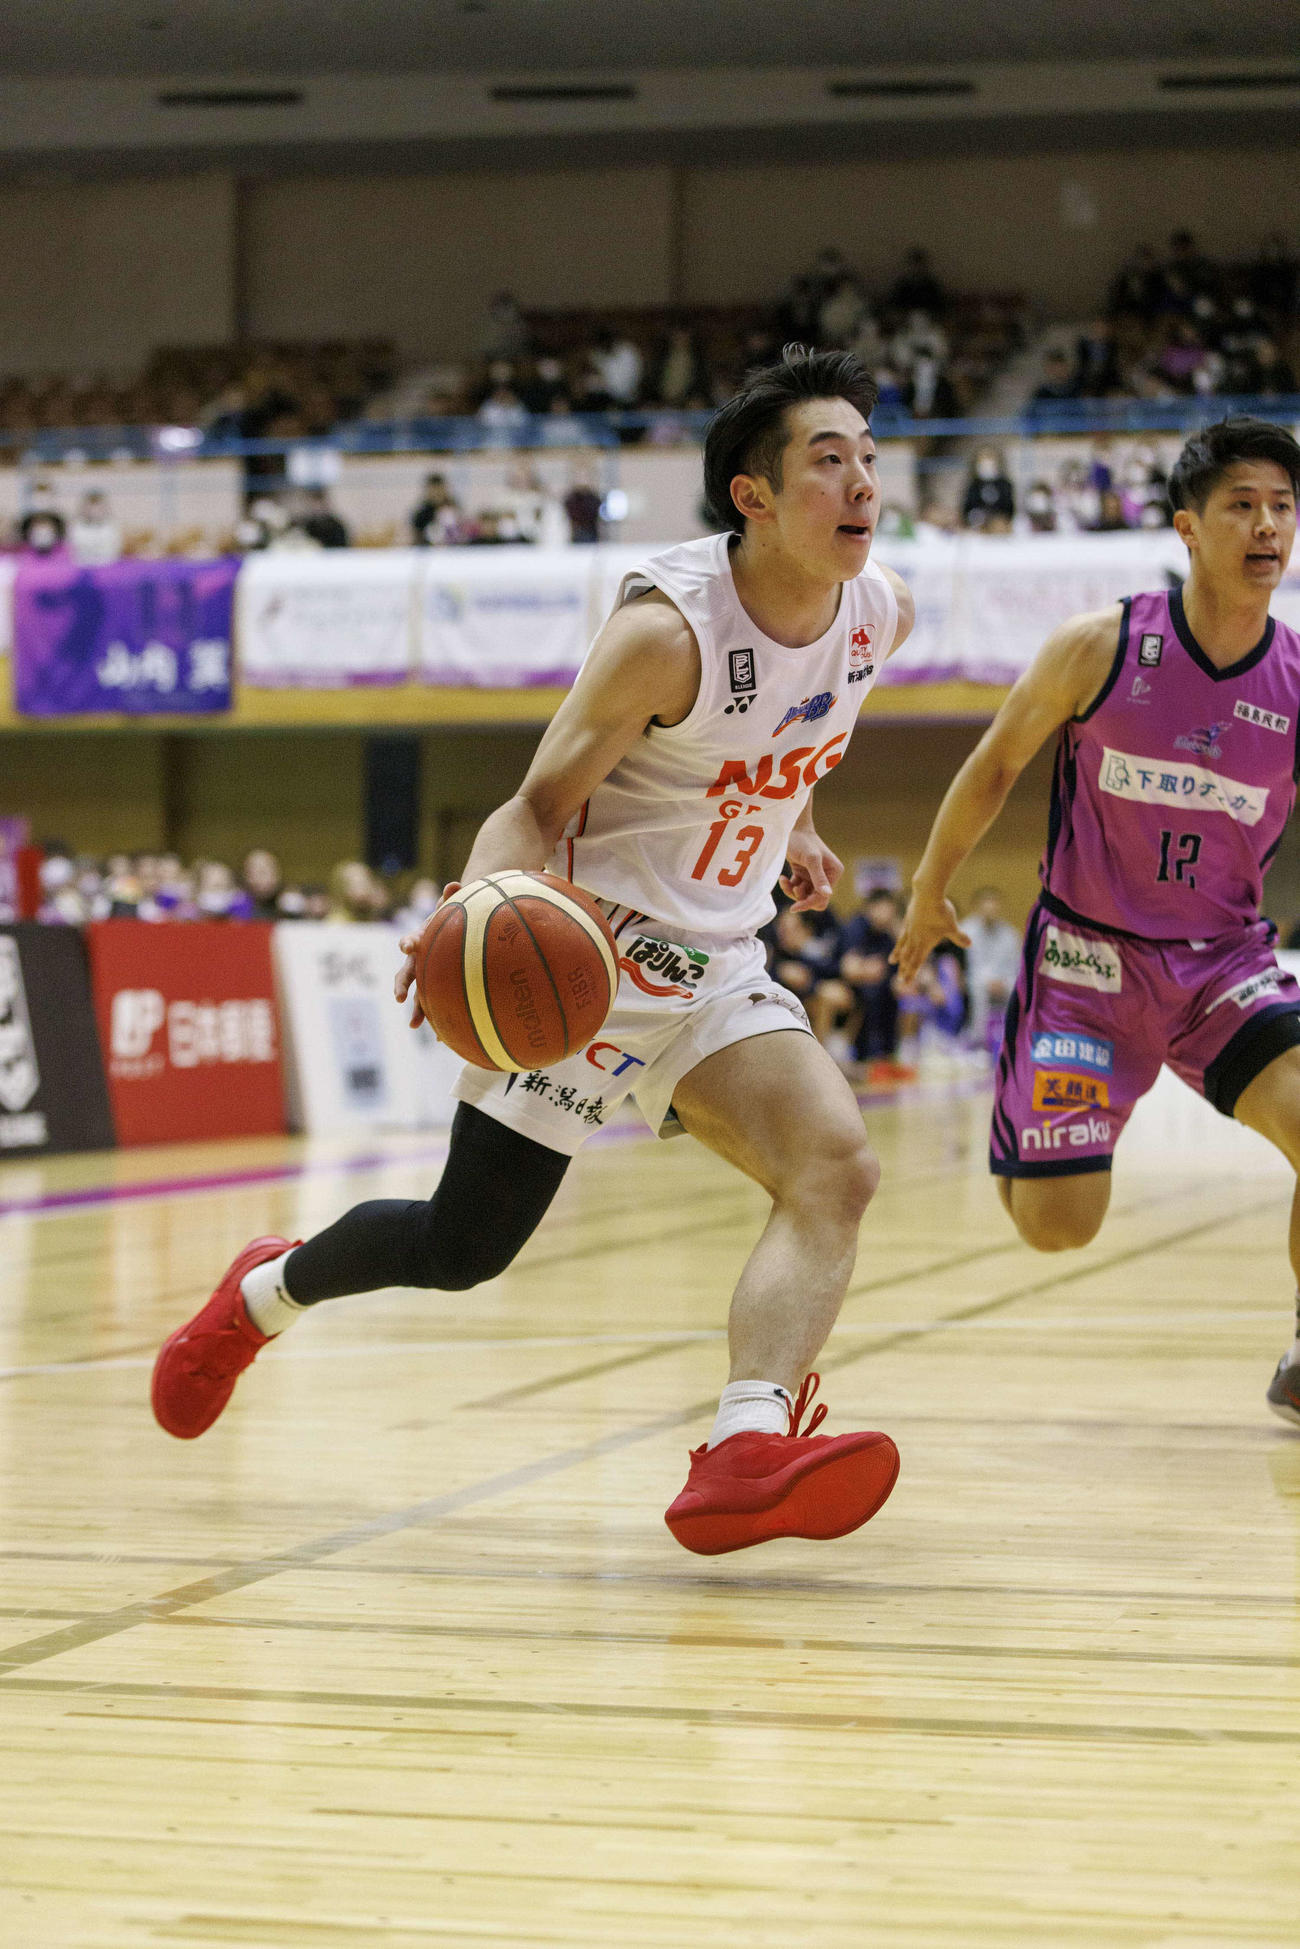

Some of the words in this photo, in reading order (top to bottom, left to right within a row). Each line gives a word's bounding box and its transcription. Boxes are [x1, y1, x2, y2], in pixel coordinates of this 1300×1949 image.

[706, 732, 848, 799] NSG
[691, 819, 764, 888] 13
[1157, 831, 1202, 889] 12
[626, 937, 704, 989] ぱりんこ
[510, 968, 547, 1048] molten
[577, 1038, 646, 1077] CT
[1022, 1117, 1110, 1149] niraku
